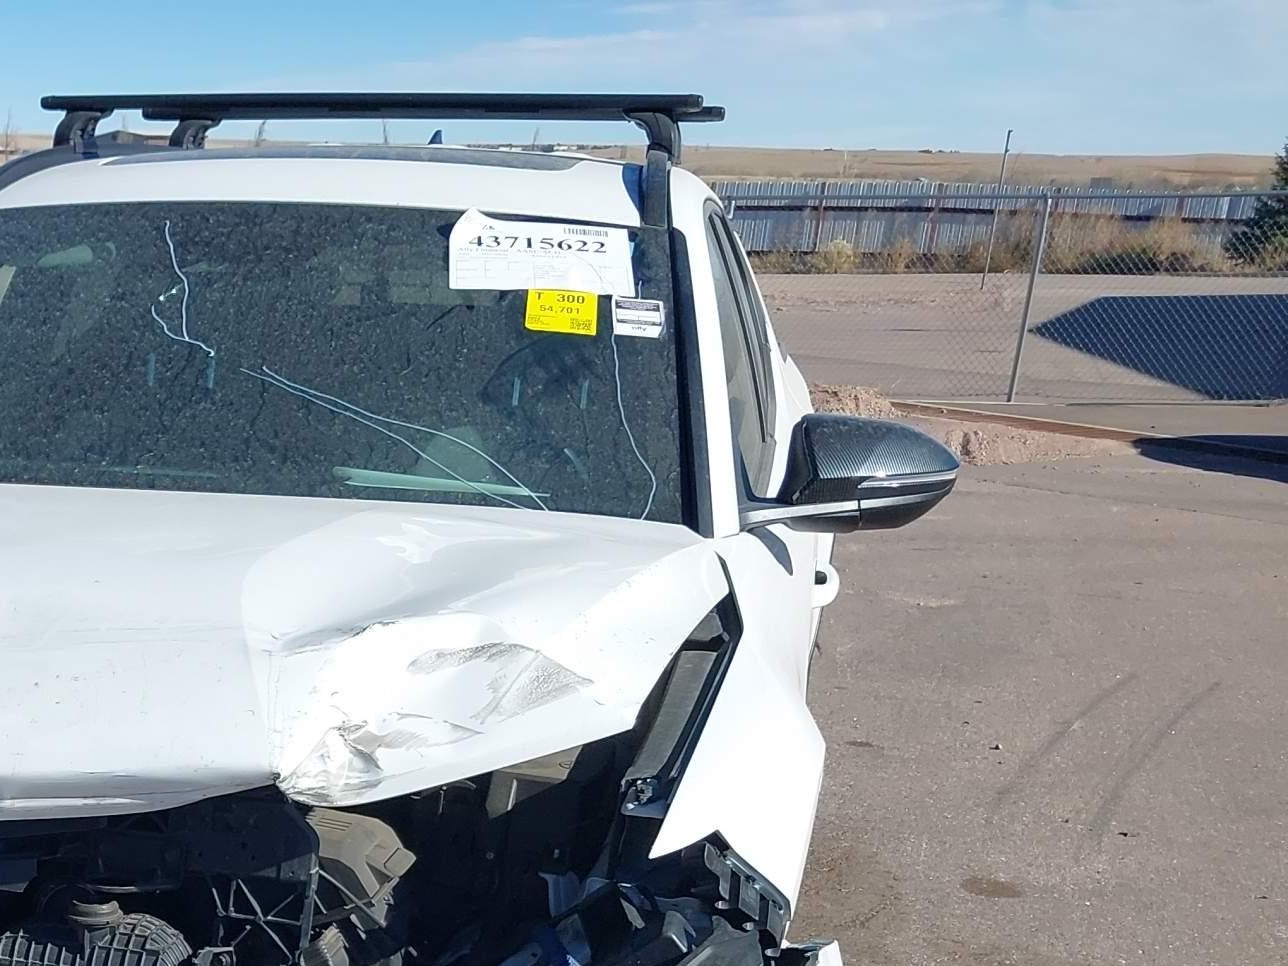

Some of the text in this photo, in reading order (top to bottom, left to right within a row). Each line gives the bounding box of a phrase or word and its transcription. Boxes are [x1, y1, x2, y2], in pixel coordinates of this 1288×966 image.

[469, 235, 607, 253] 43715622
[535, 292, 585, 304] T 300
[539, 304, 581, 314] 54,701
